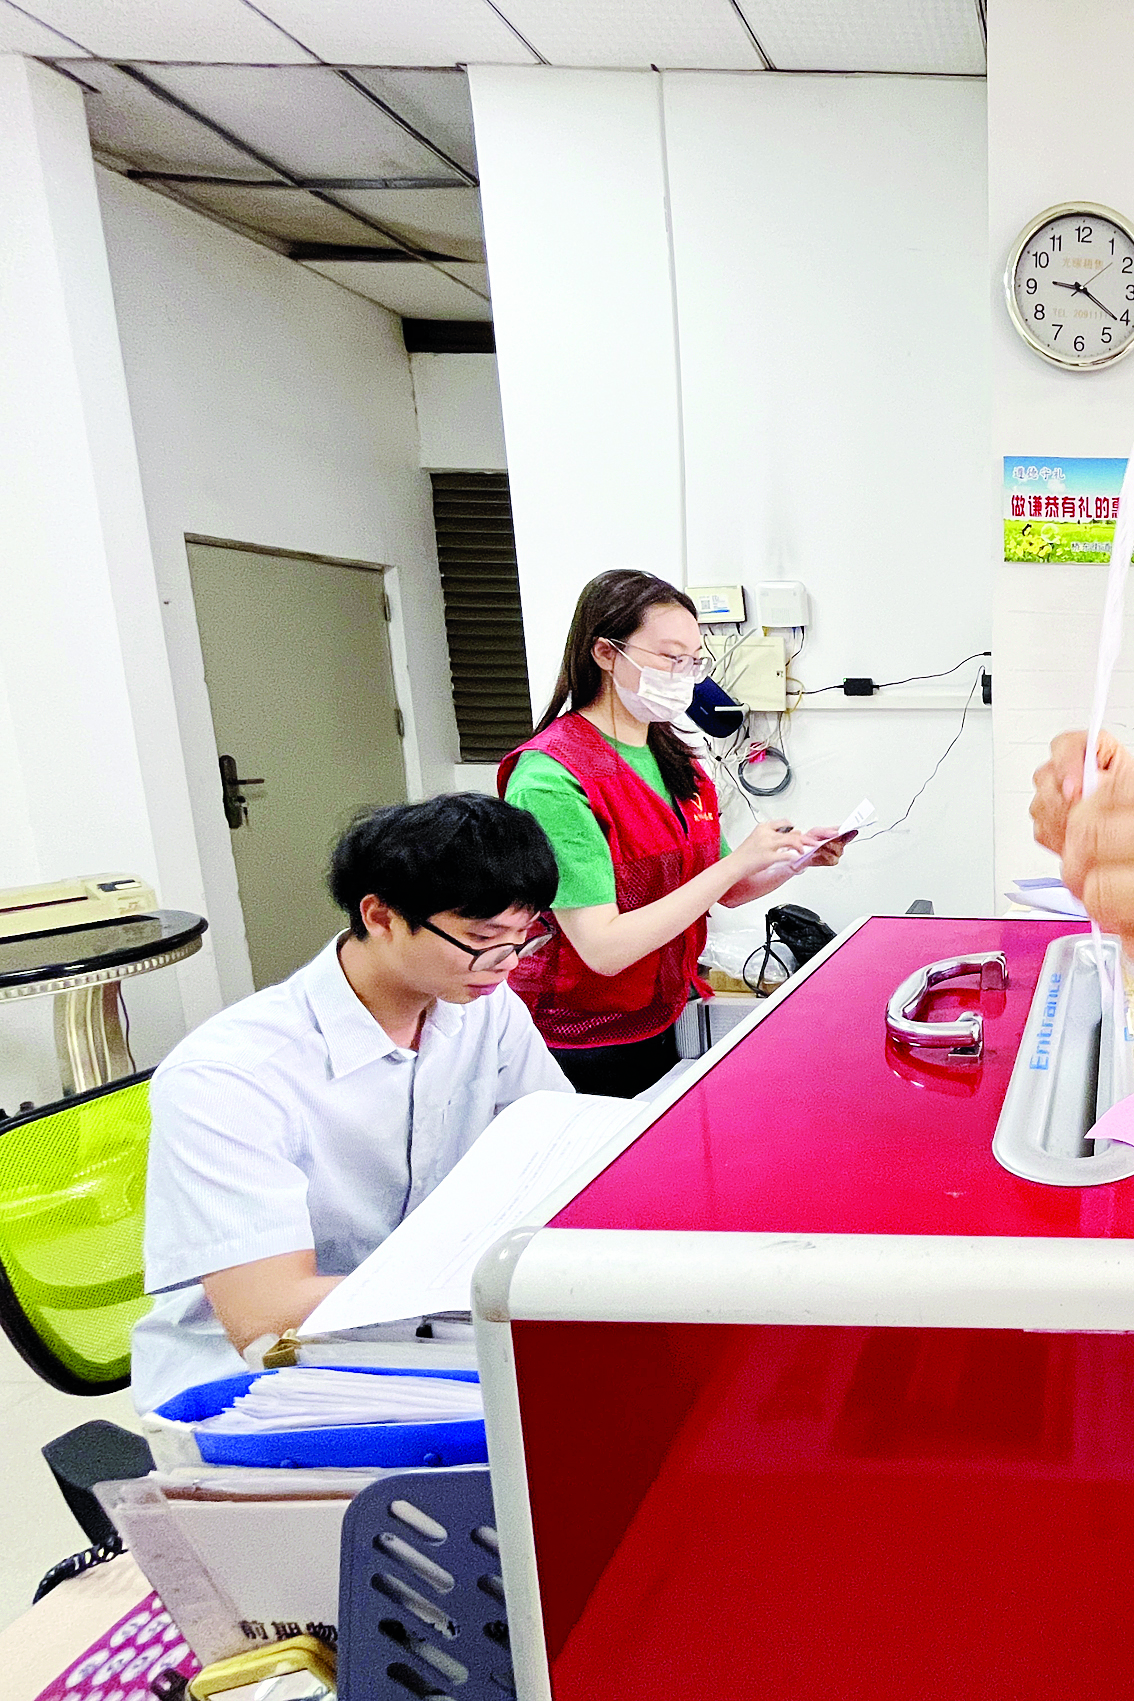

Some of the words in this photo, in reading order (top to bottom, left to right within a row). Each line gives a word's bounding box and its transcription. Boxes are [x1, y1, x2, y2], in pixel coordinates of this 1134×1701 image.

[1075, 226, 1093, 243] 12
[1050, 235, 1062, 252] 11
[1109, 238, 1115, 255] 1
[1032, 251, 1049, 268] 10
[1122, 257, 1133, 274] 2
[1026, 278, 1038, 295] 9
[1034, 304, 1045, 320] 8
[1120, 309, 1131, 326] 4
[1051, 324, 1063, 341] 7
[1101, 327, 1112, 343] 5
[1074, 336, 1085, 352] 6
[1029, 972, 1062, 1070] Entrance
